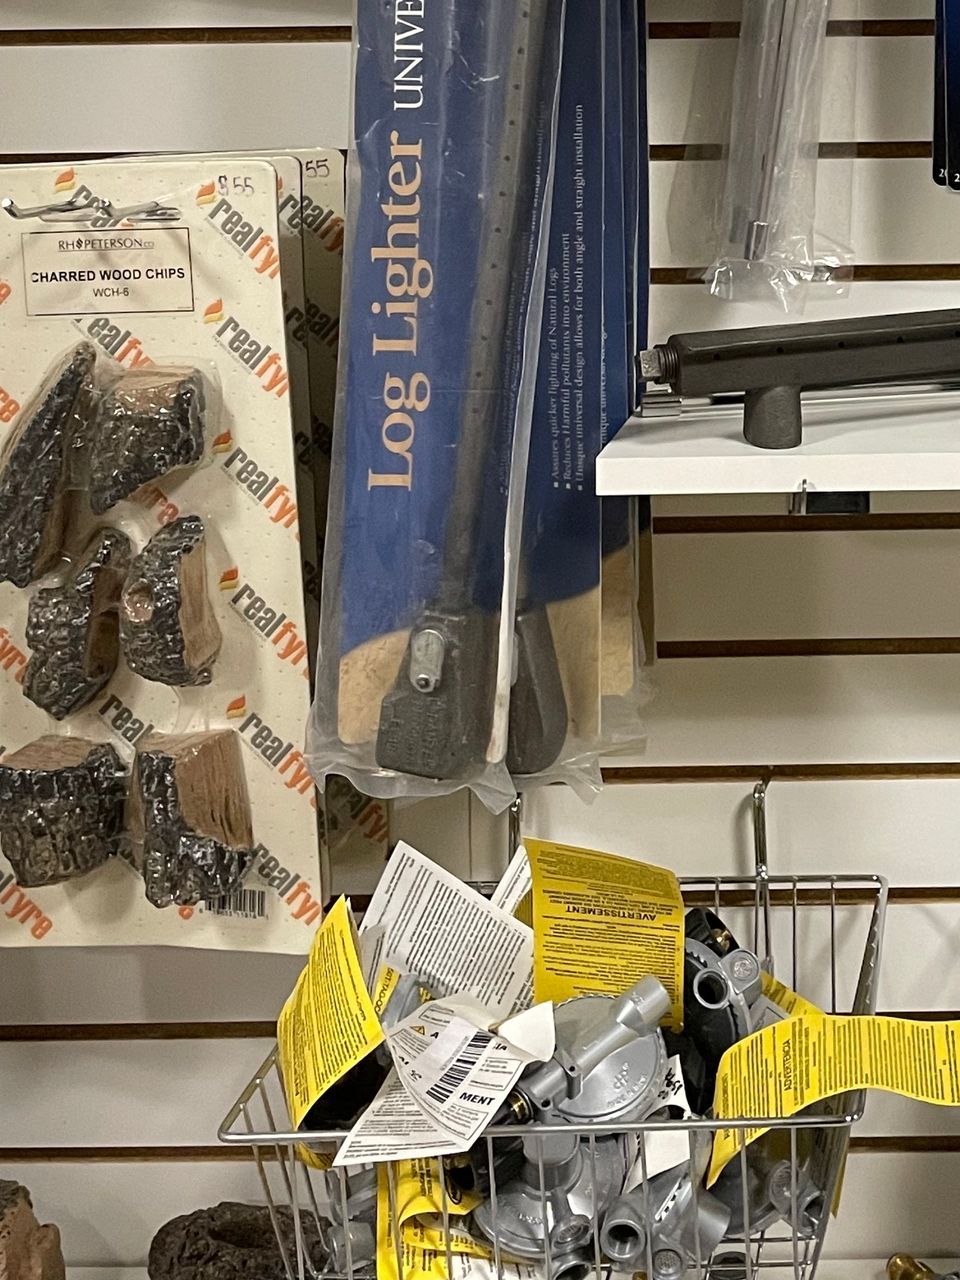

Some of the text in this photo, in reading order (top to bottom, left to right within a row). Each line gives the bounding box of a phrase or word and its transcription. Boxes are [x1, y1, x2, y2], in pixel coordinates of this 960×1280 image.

[574, 104, 583, 166] installation
[574, 168, 585, 209] straight
[574, 211, 583, 233] and
[574, 235, 585, 264] angle
[31, 267, 185, 283] CHARRED WOOD CHIPS
[548, 267, 559, 292] Logs
[561, 233, 570, 303] environment
[574, 268, 583, 293] both
[93, 286, 129, 298] WCH-6
[574, 296, 583, 312] for
[368, 130, 433, 492] Lighter Log
[547, 295, 557, 336] Natural
[561, 305, 570, 328] into
[548, 337, 557, 350] of
[574, 314, 583, 349] allows
[561, 330, 571, 386] pollutants
[574, 351, 585, 387] design
[550, 397, 560, 437] quicker
[574, 389, 583, 438] universal
[565, 905, 656, 921] AVERTISSEMENT
